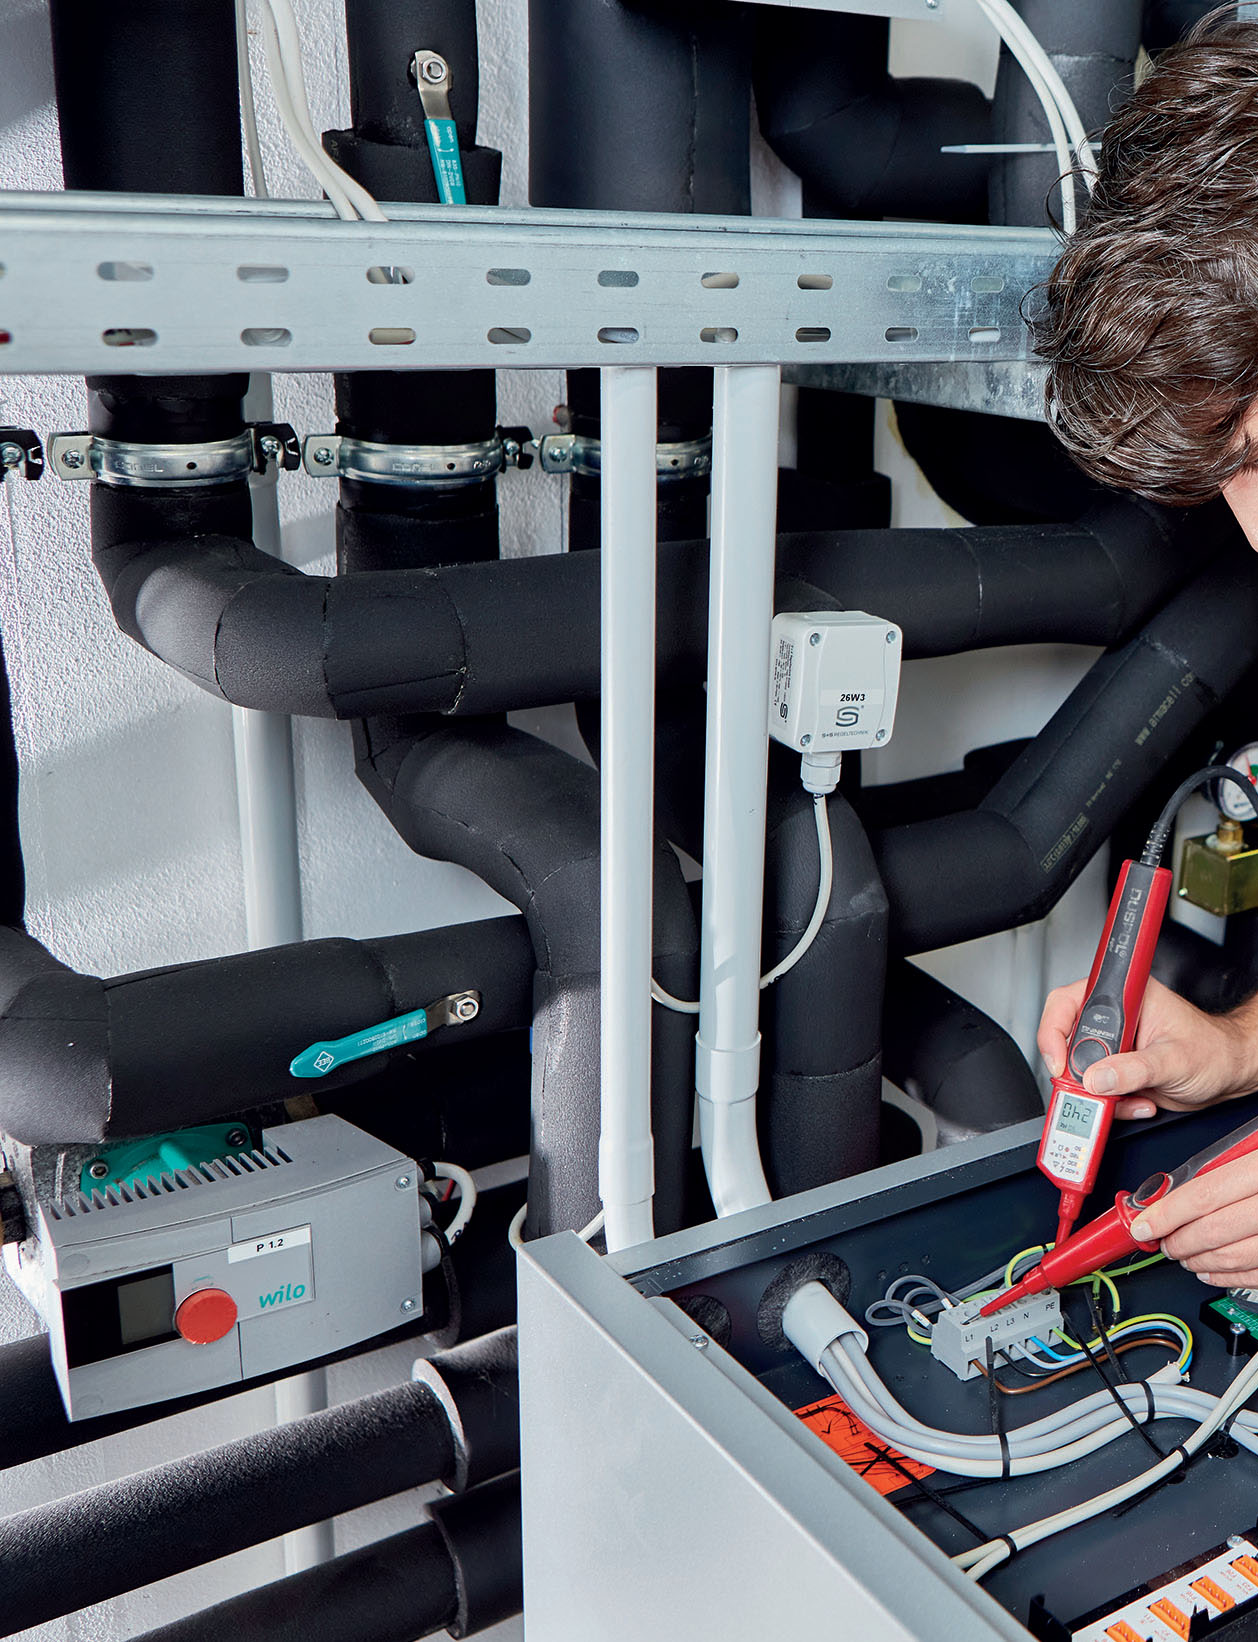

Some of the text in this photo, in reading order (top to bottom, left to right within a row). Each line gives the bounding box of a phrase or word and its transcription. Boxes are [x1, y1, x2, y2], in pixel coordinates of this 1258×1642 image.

[840, 693, 866, 702] 26W3
[256, 1238, 284, 1253] P 1.2
[258, 1283, 306, 1308] wilo
[965, 1334, 974, 1343] L1
[990, 1323, 1000, 1333] L2
[1006, 1317, 1016, 1327] L3
[1045, 1301, 1056, 1311] PE
